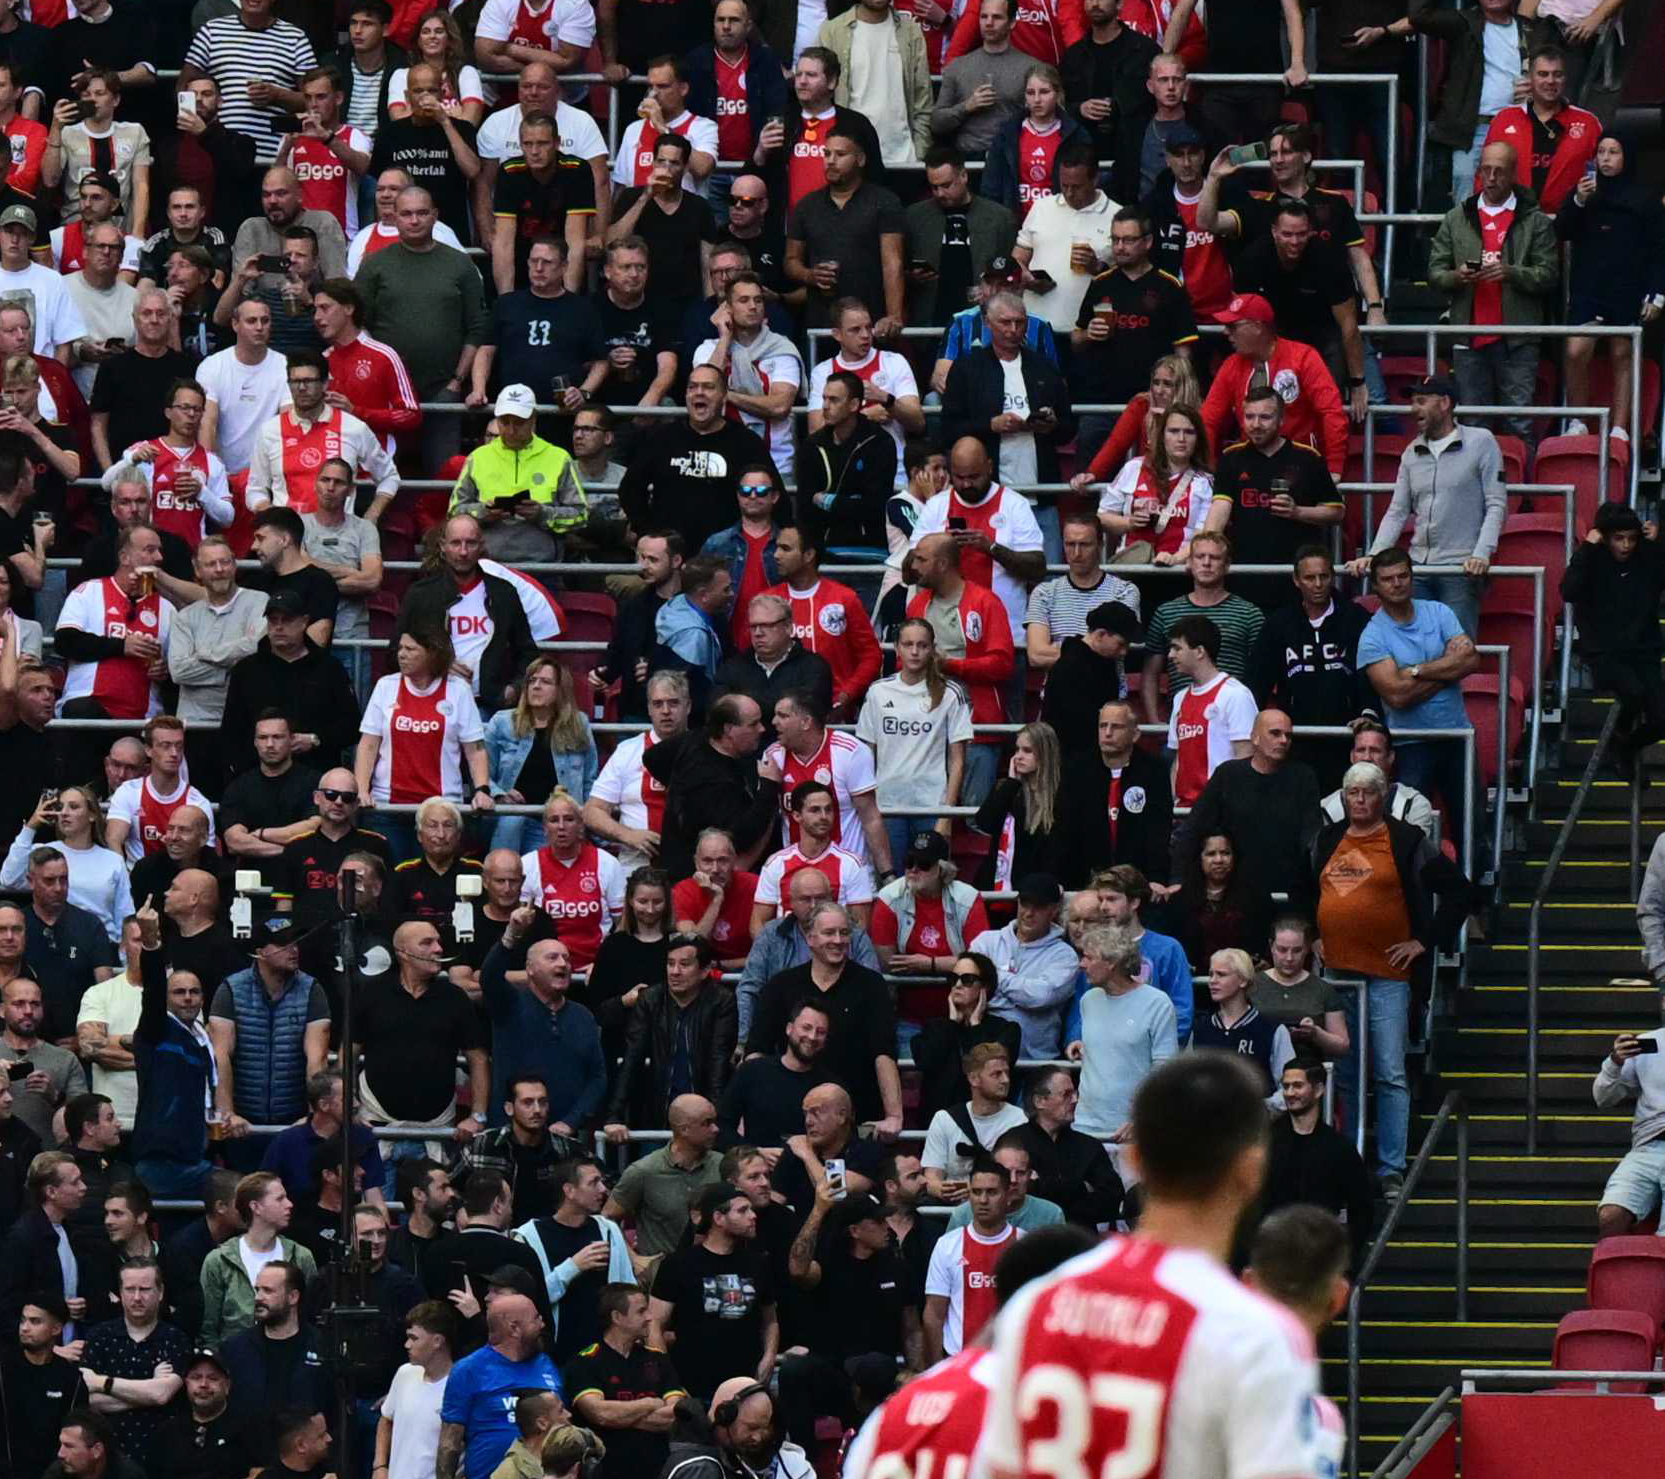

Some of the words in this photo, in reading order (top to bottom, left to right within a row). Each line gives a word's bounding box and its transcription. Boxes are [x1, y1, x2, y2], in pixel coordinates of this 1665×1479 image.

[794, 141, 828, 158] Zigg
[295, 162, 344, 181] Ziggo
[1018, 184, 1053, 200] Zigg
[396, 717, 440, 732] Ziggo
[882, 717, 931, 736] Ziggo
[545, 899, 600, 916] Ziggo
[1238, 1040, 1255, 1056] RL
